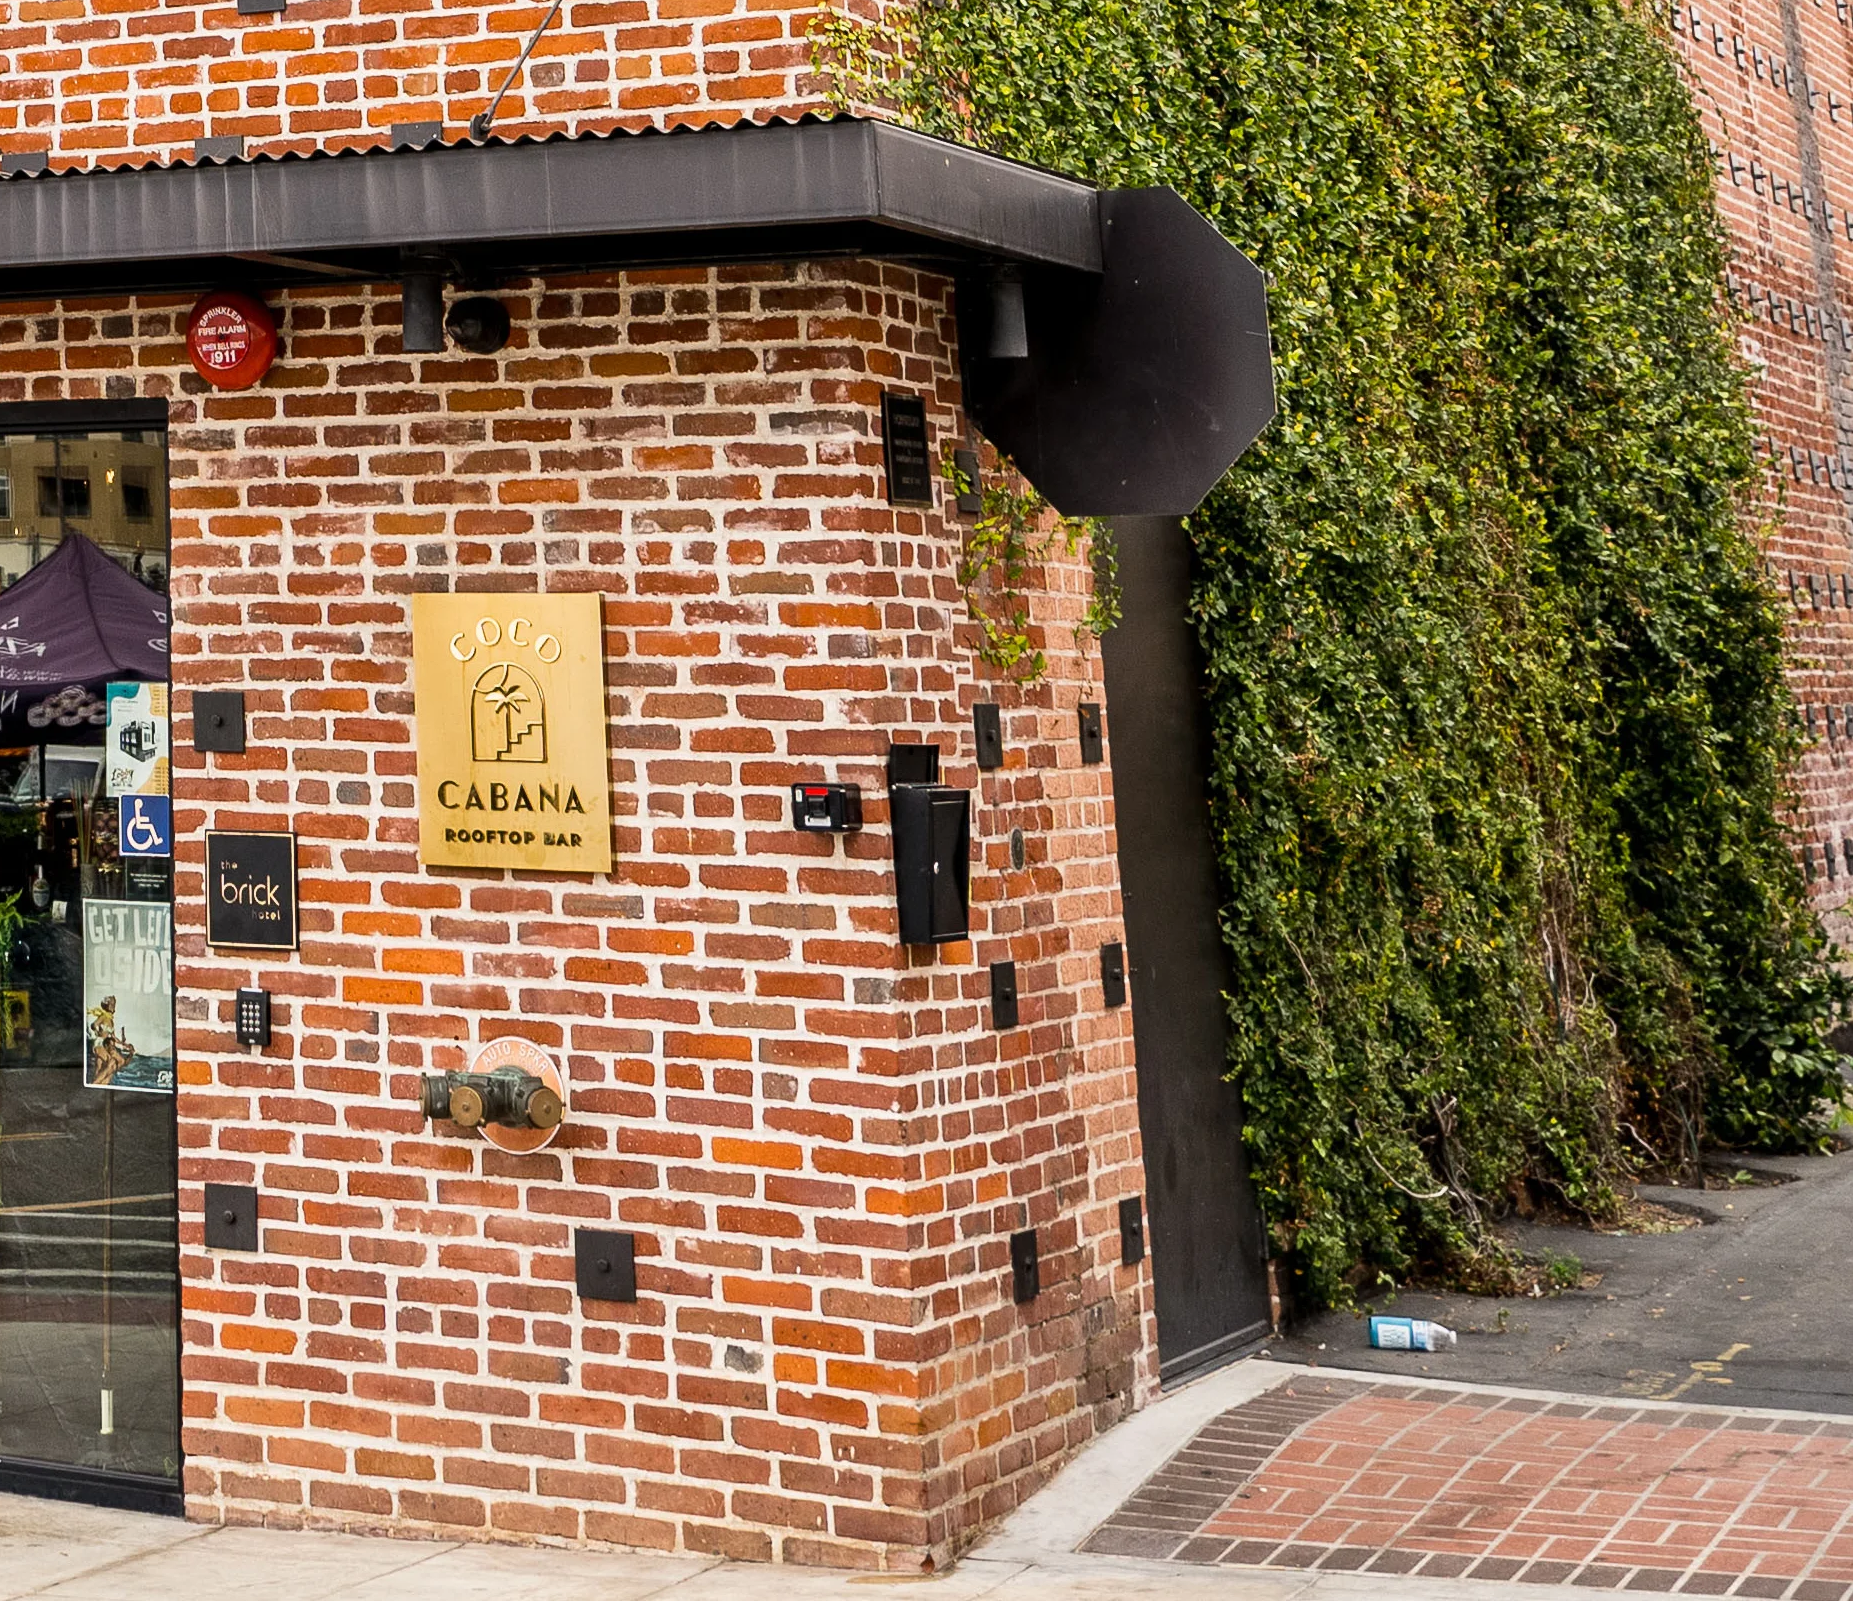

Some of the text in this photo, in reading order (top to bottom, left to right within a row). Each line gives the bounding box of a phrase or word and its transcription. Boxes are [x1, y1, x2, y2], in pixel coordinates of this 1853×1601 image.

[200, 306, 242, 327] SPRINKLER
[198, 325, 246, 336] FIRE ALARM
[215, 350, 236, 363] 911
[449, 616, 562, 664] COCO
[437, 780, 586, 815] CABANA
[445, 827, 583, 848] ROOFTOP BAR
[220, 860, 238, 871] the
[220, 873, 280, 906] brick
[87, 905, 129, 944] GET
[251, 909, 281, 921] hotel
[481, 1041, 550, 1072] AUTO SPKR
